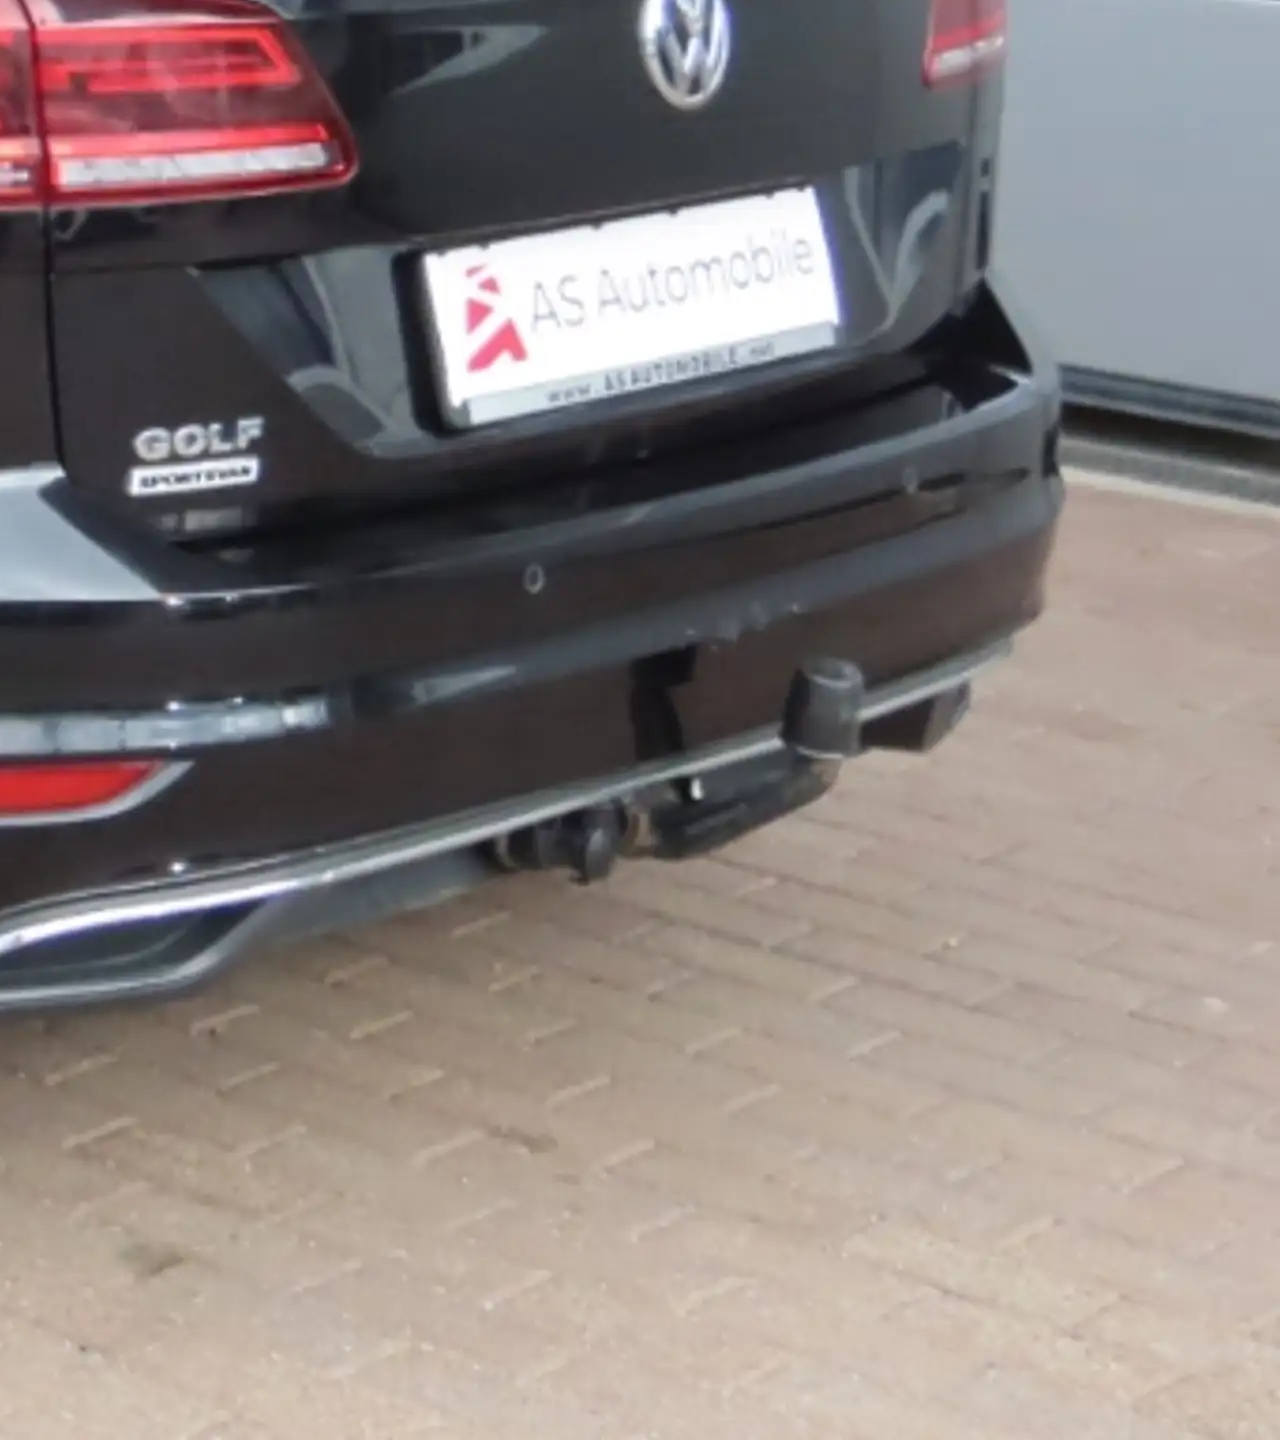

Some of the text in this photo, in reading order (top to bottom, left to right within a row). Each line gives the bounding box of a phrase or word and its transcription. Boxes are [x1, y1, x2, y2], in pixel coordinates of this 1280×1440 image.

[530, 227, 814, 333] AS Automobile
[133, 415, 266, 462] GOLF
